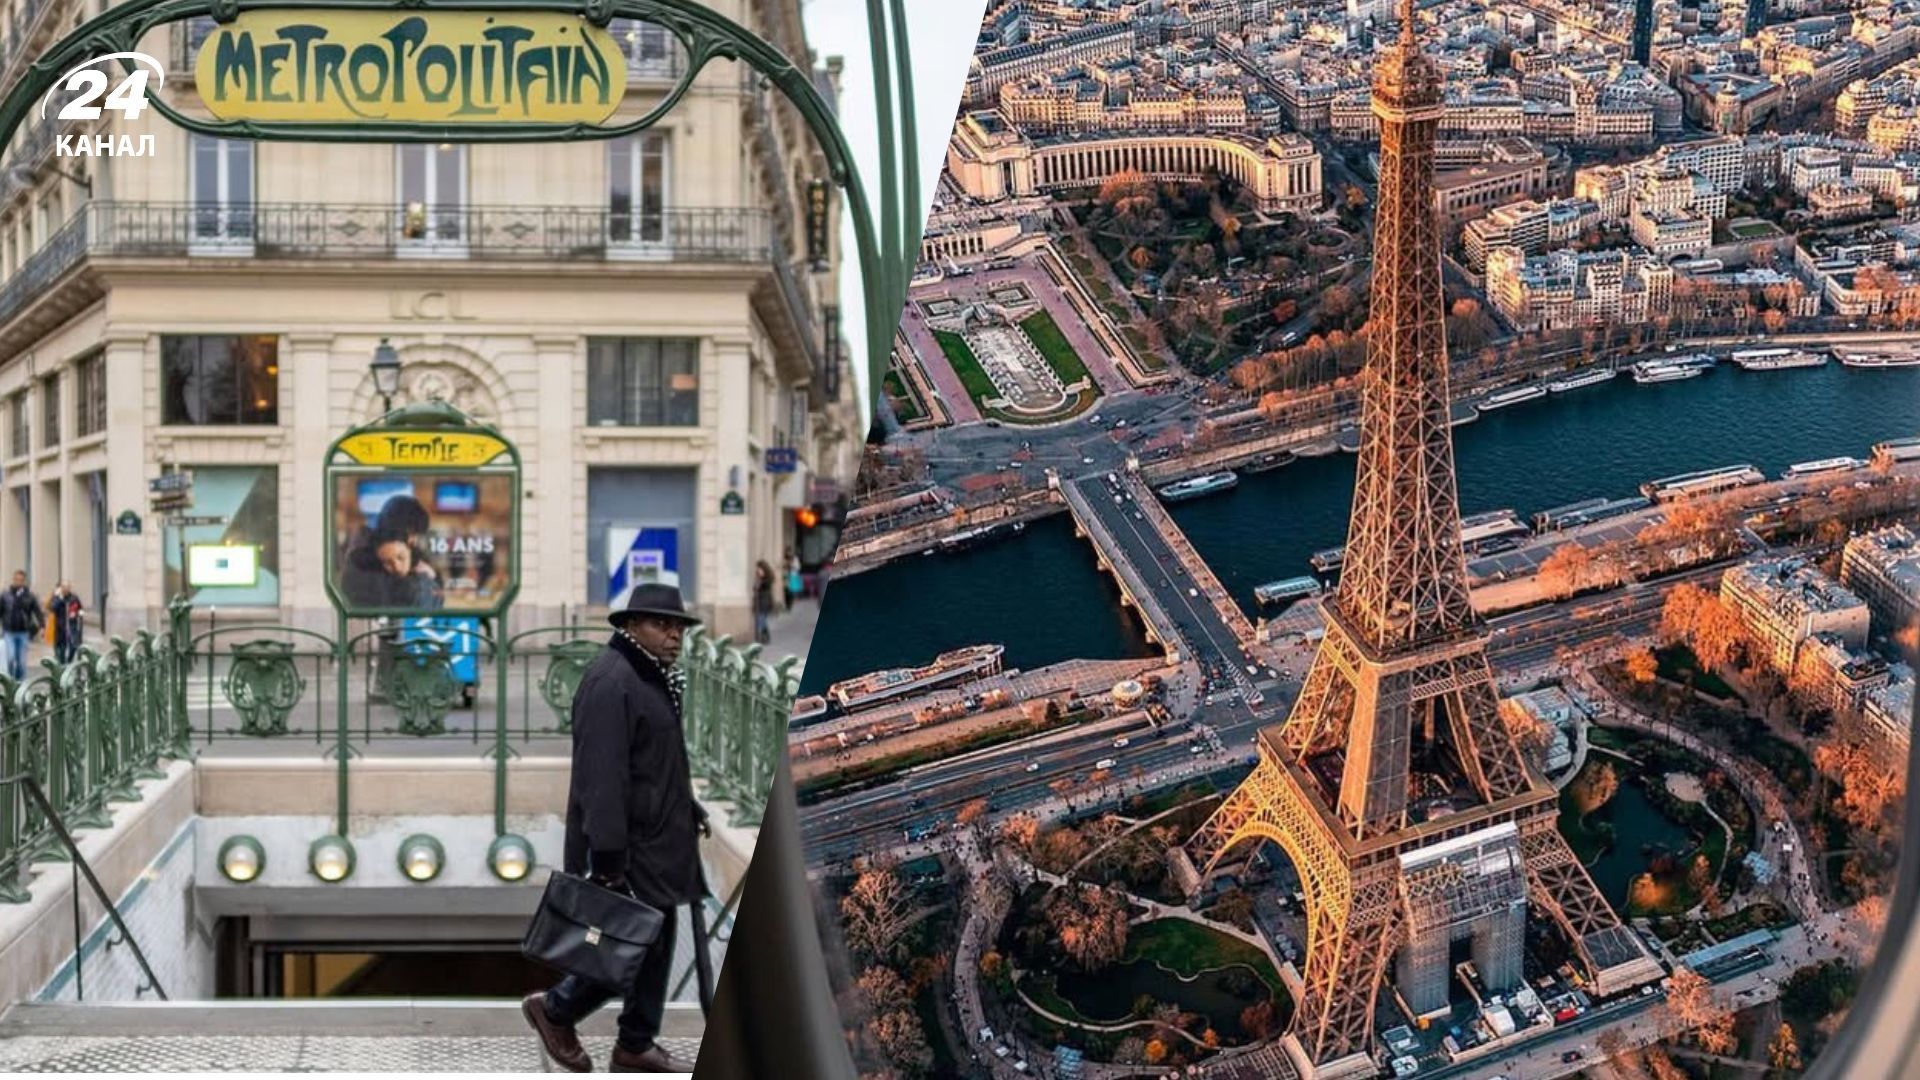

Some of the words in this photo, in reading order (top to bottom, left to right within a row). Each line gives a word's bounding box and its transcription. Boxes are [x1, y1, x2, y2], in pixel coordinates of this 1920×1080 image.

[390, 291, 478, 321] LCL
[384, 437, 460, 462] TEMPLE
[430, 537, 449, 553] 16
[452, 536, 495, 553] ANS
